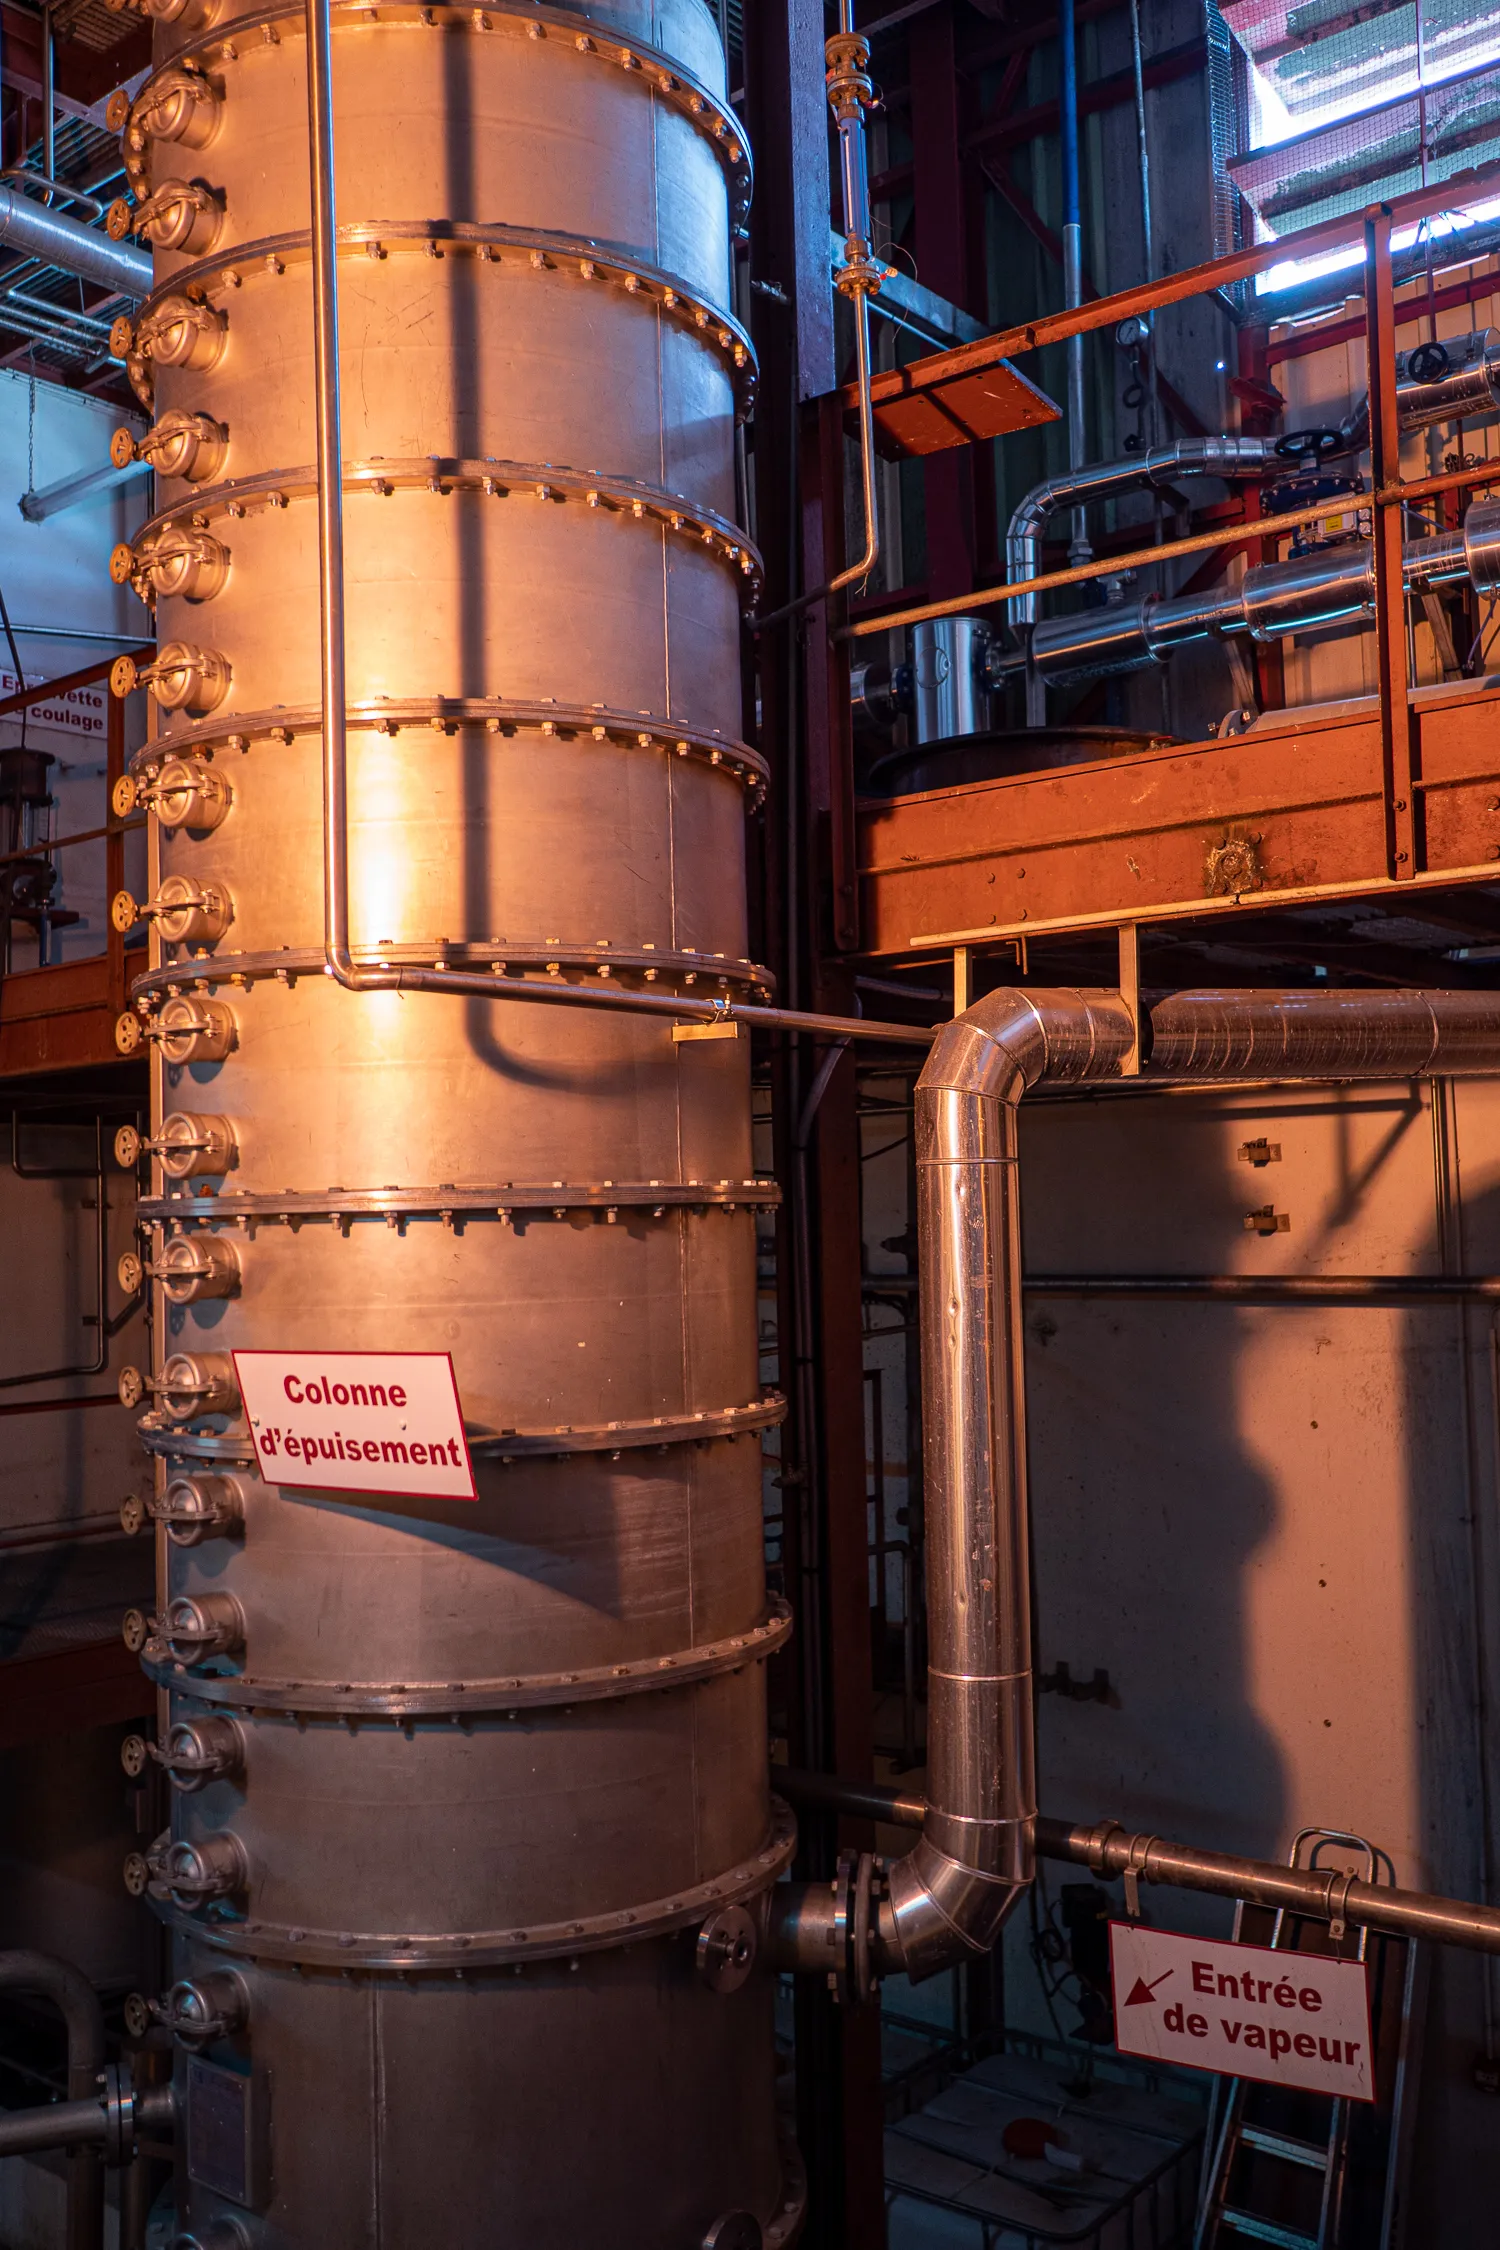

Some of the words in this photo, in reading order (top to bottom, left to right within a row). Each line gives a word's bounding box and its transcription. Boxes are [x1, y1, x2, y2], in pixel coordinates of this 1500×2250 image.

[31, 706, 104, 731] coulage
[283, 1374, 407, 1407] Colonne
[259, 1427, 463, 1467] d'épuisement
[1191, 1961, 1322, 2012] Entrée
[1163, 2002, 1209, 2038] de
[1220, 2018, 1361, 2067] vapeur
